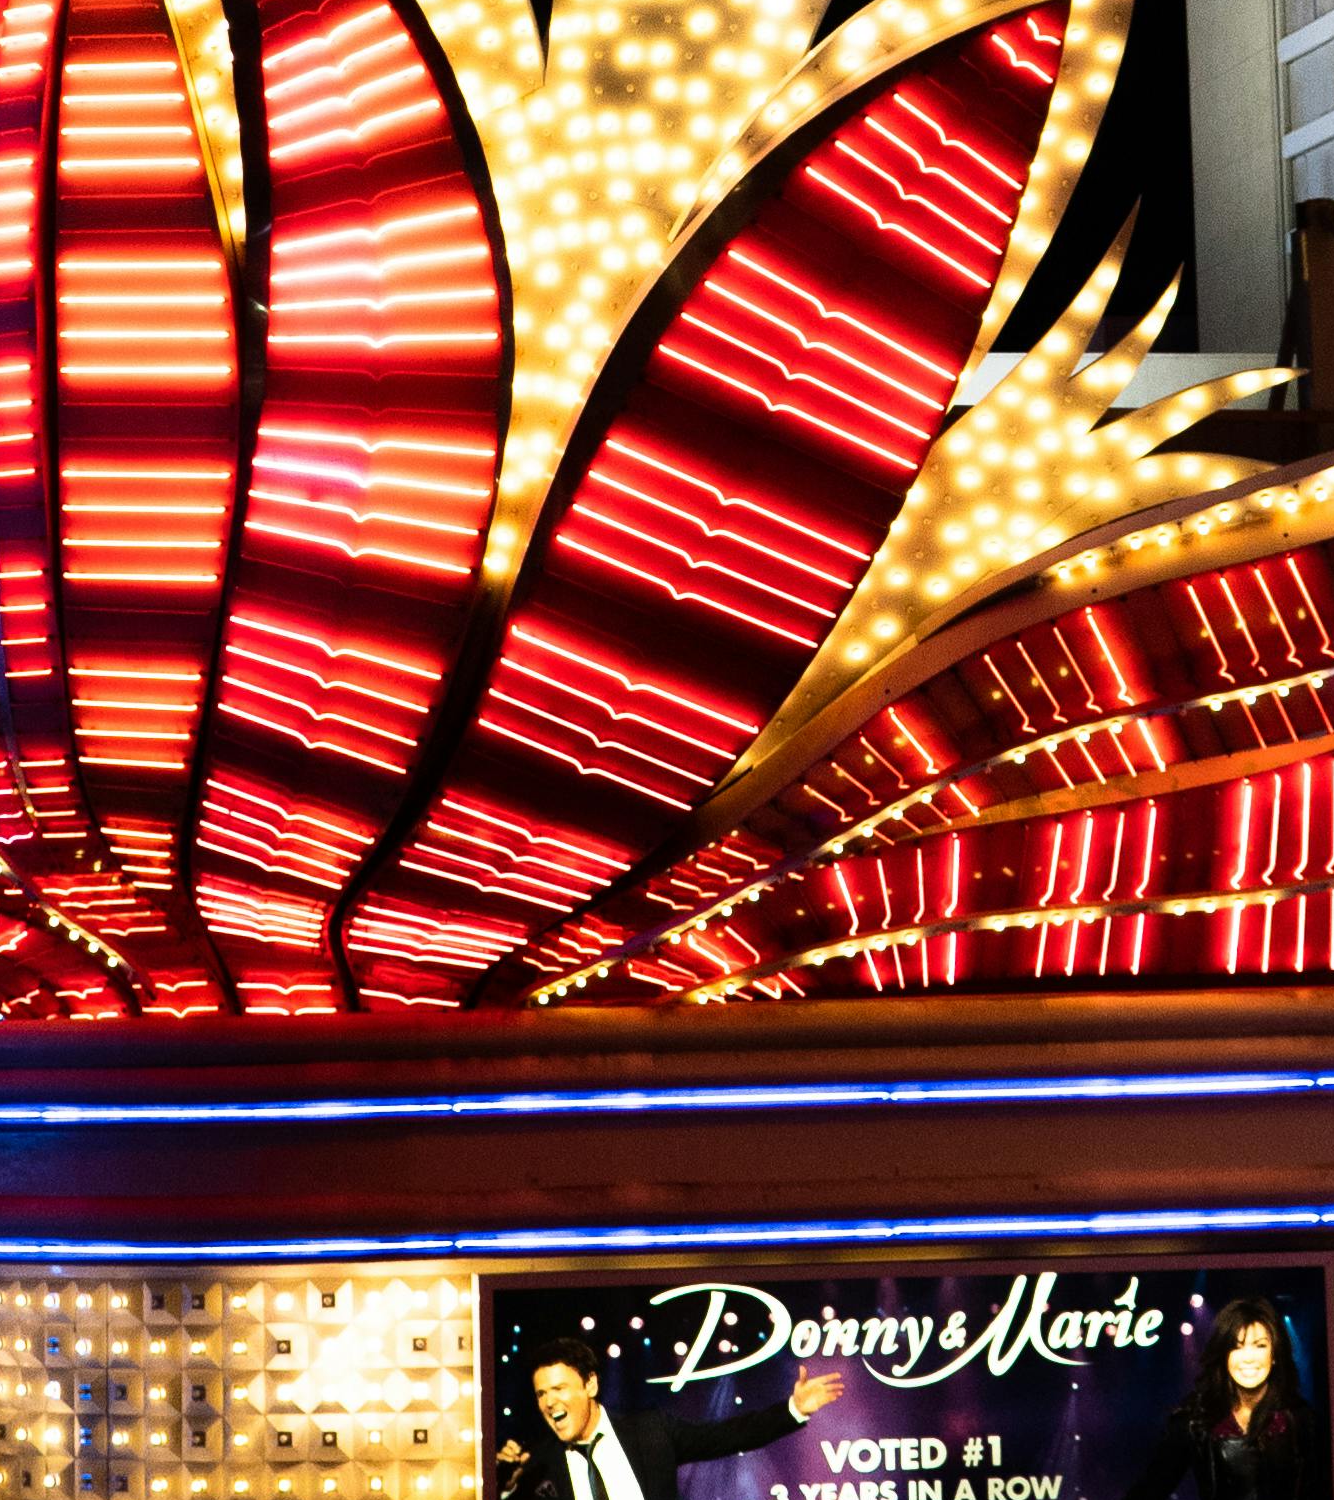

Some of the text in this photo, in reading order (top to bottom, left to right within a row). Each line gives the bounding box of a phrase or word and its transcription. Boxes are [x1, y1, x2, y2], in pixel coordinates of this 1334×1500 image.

[646, 1271, 1165, 1392] Donny & Marie
[820, 1435, 1002, 1473] VOTED #1
